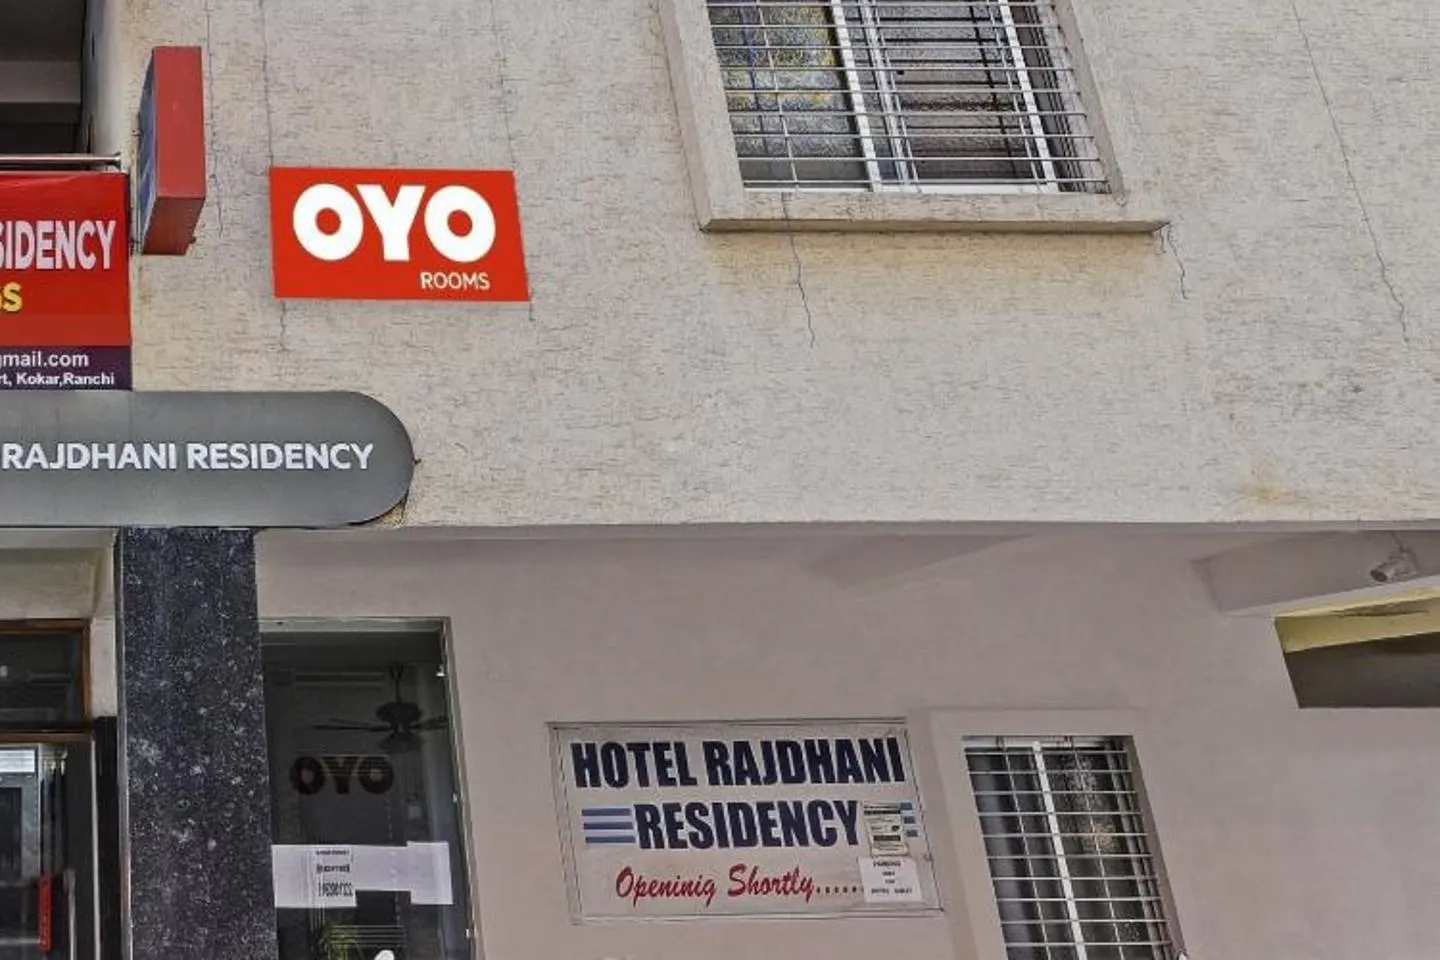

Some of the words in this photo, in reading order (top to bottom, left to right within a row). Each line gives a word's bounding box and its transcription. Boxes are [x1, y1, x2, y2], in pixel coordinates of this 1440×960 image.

[293, 183, 496, 263] OYO
[420, 272, 491, 290] ROOMS
[1, 443, 177, 470] RAJDHANI
[187, 443, 374, 470] RESIDENCY
[290, 755, 394, 795] OYO
[570, 742, 698, 788] HOTEL
[702, 736, 905, 786] RAJDHANI
[634, 799, 859, 849] RESIDENCY
